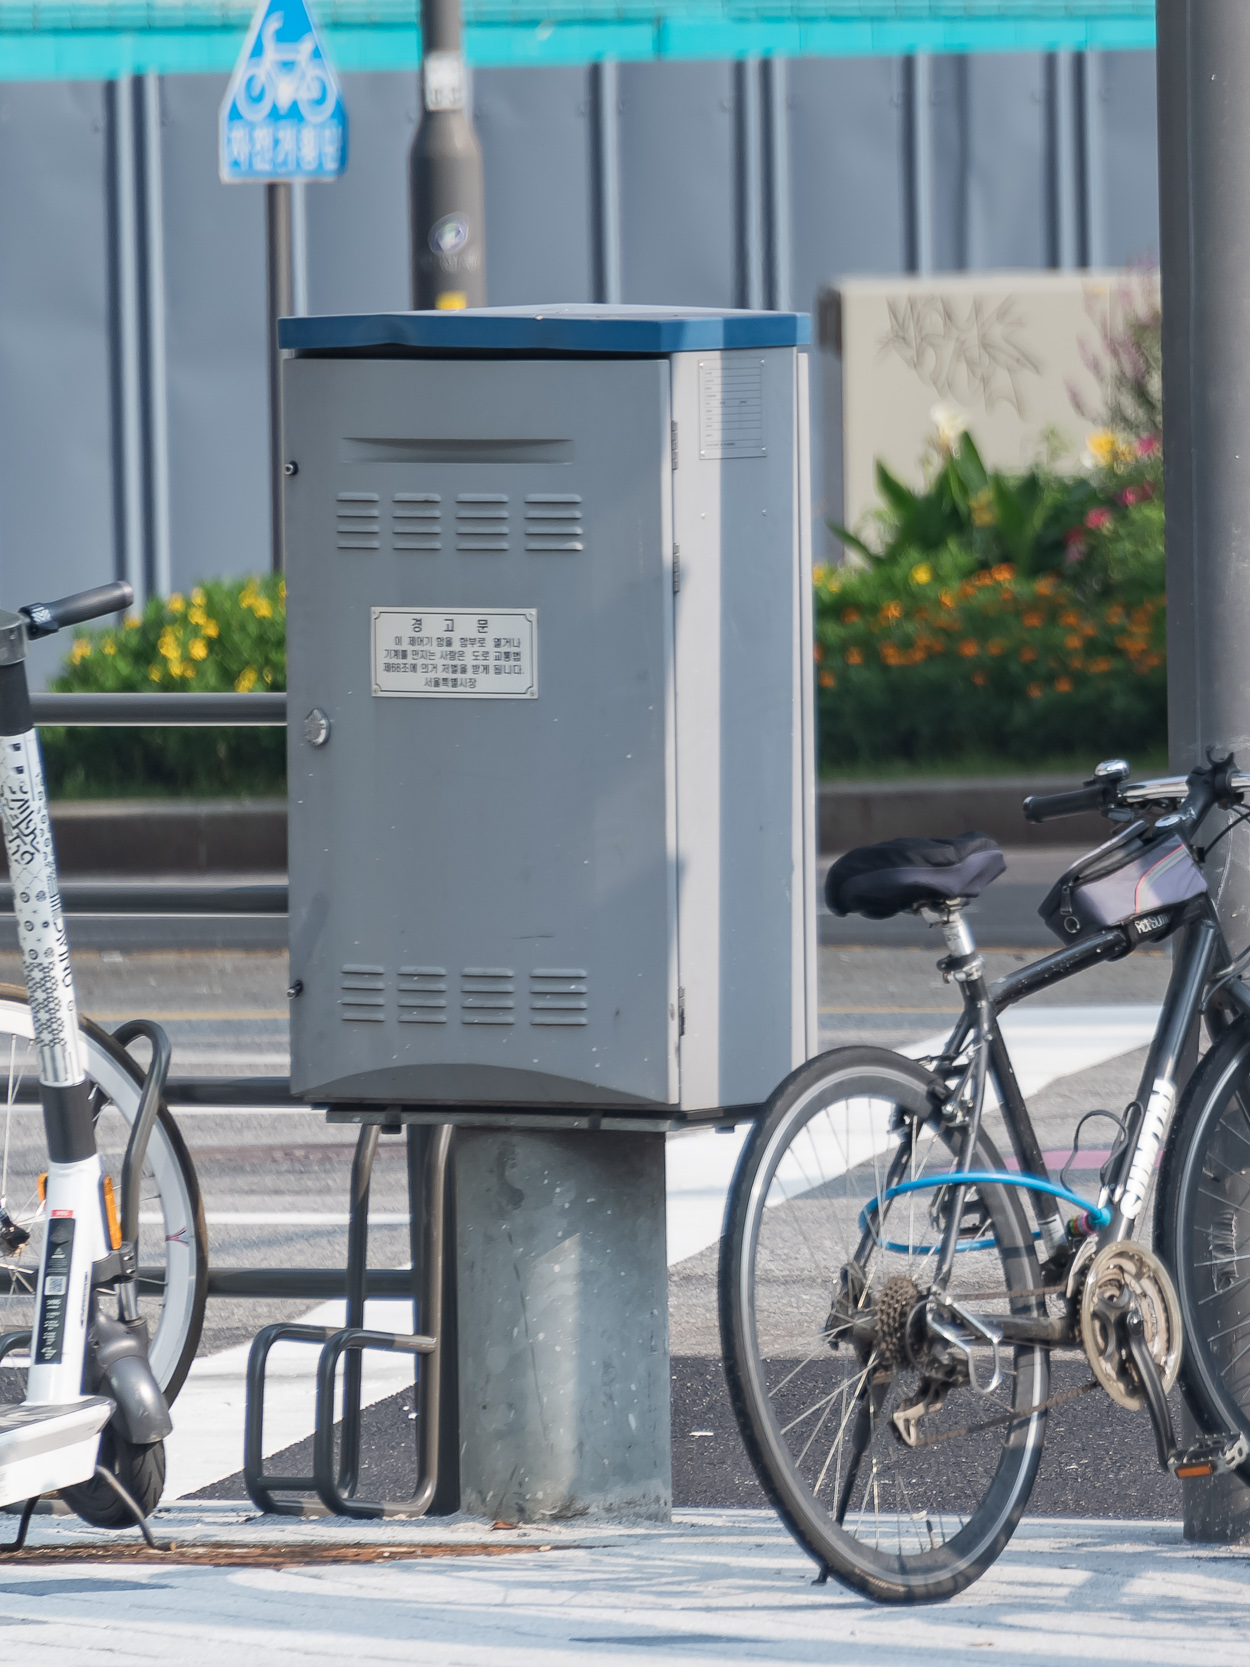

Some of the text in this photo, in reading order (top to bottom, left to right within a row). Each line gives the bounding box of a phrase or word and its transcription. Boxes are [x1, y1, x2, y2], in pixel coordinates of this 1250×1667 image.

[411, 617, 489, 634] 경 고 문
[394, 635, 521, 648] 이 제어기 함을 함부로 열거나
[383, 649, 521, 662] 기계를 만지는 사람은 도로 교통법
[421, 663, 438, 674] 의거
[440, 663, 468, 675] 처벌을
[471, 664, 490, 675] 받게
[424, 677, 477, 689] 서울특별시장
